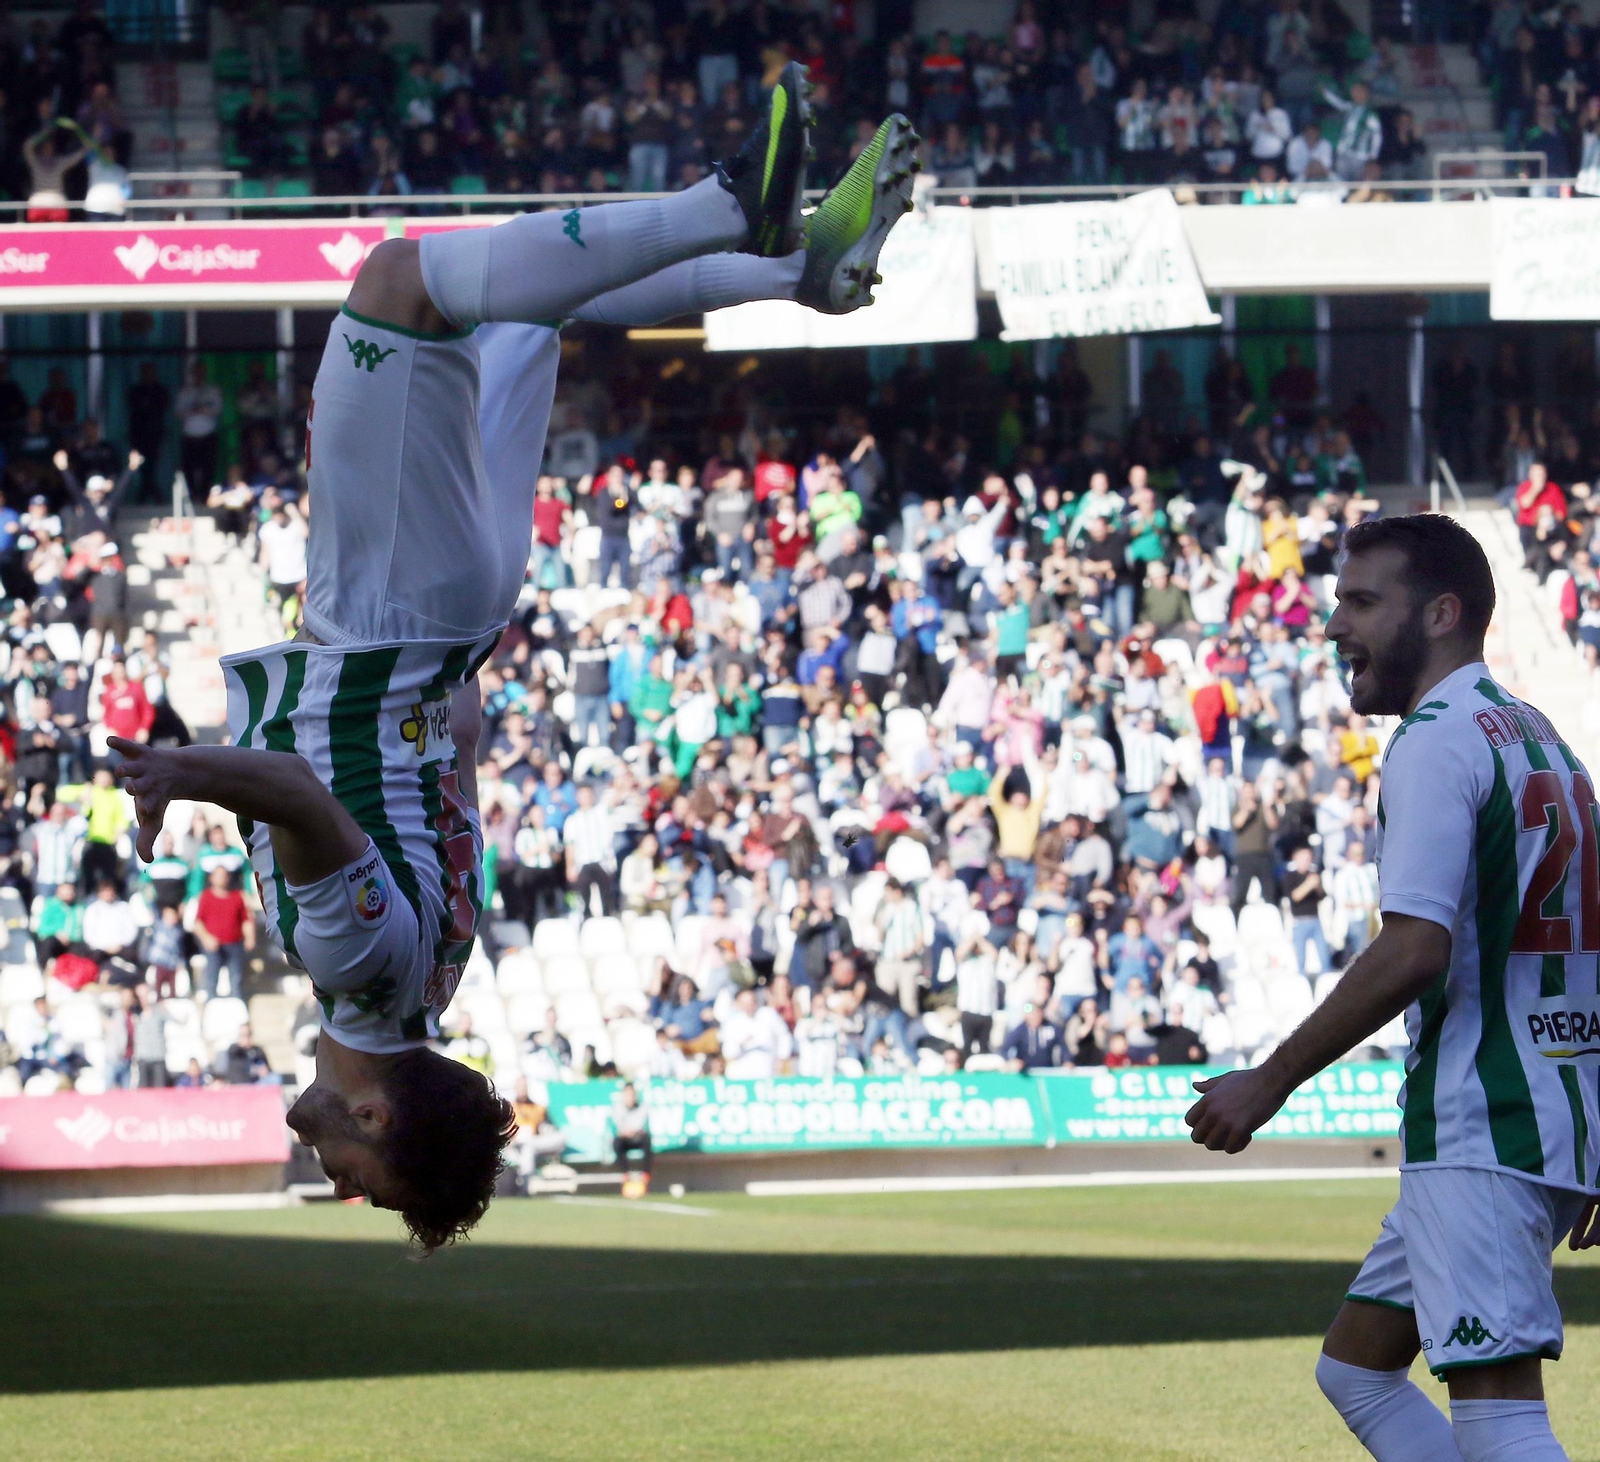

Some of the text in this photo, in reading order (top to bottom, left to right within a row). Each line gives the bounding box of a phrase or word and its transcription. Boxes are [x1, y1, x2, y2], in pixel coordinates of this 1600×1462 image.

[0, 247, 50, 274] Sur
[159, 243, 261, 276] CajaSur
[348, 857, 379, 883] LaLiga
[754, 1073, 857, 1103] tienda
[113, 1112, 248, 1146] CajaSur
[565, 1097, 1035, 1137] WW.CORDOBACF.COM
